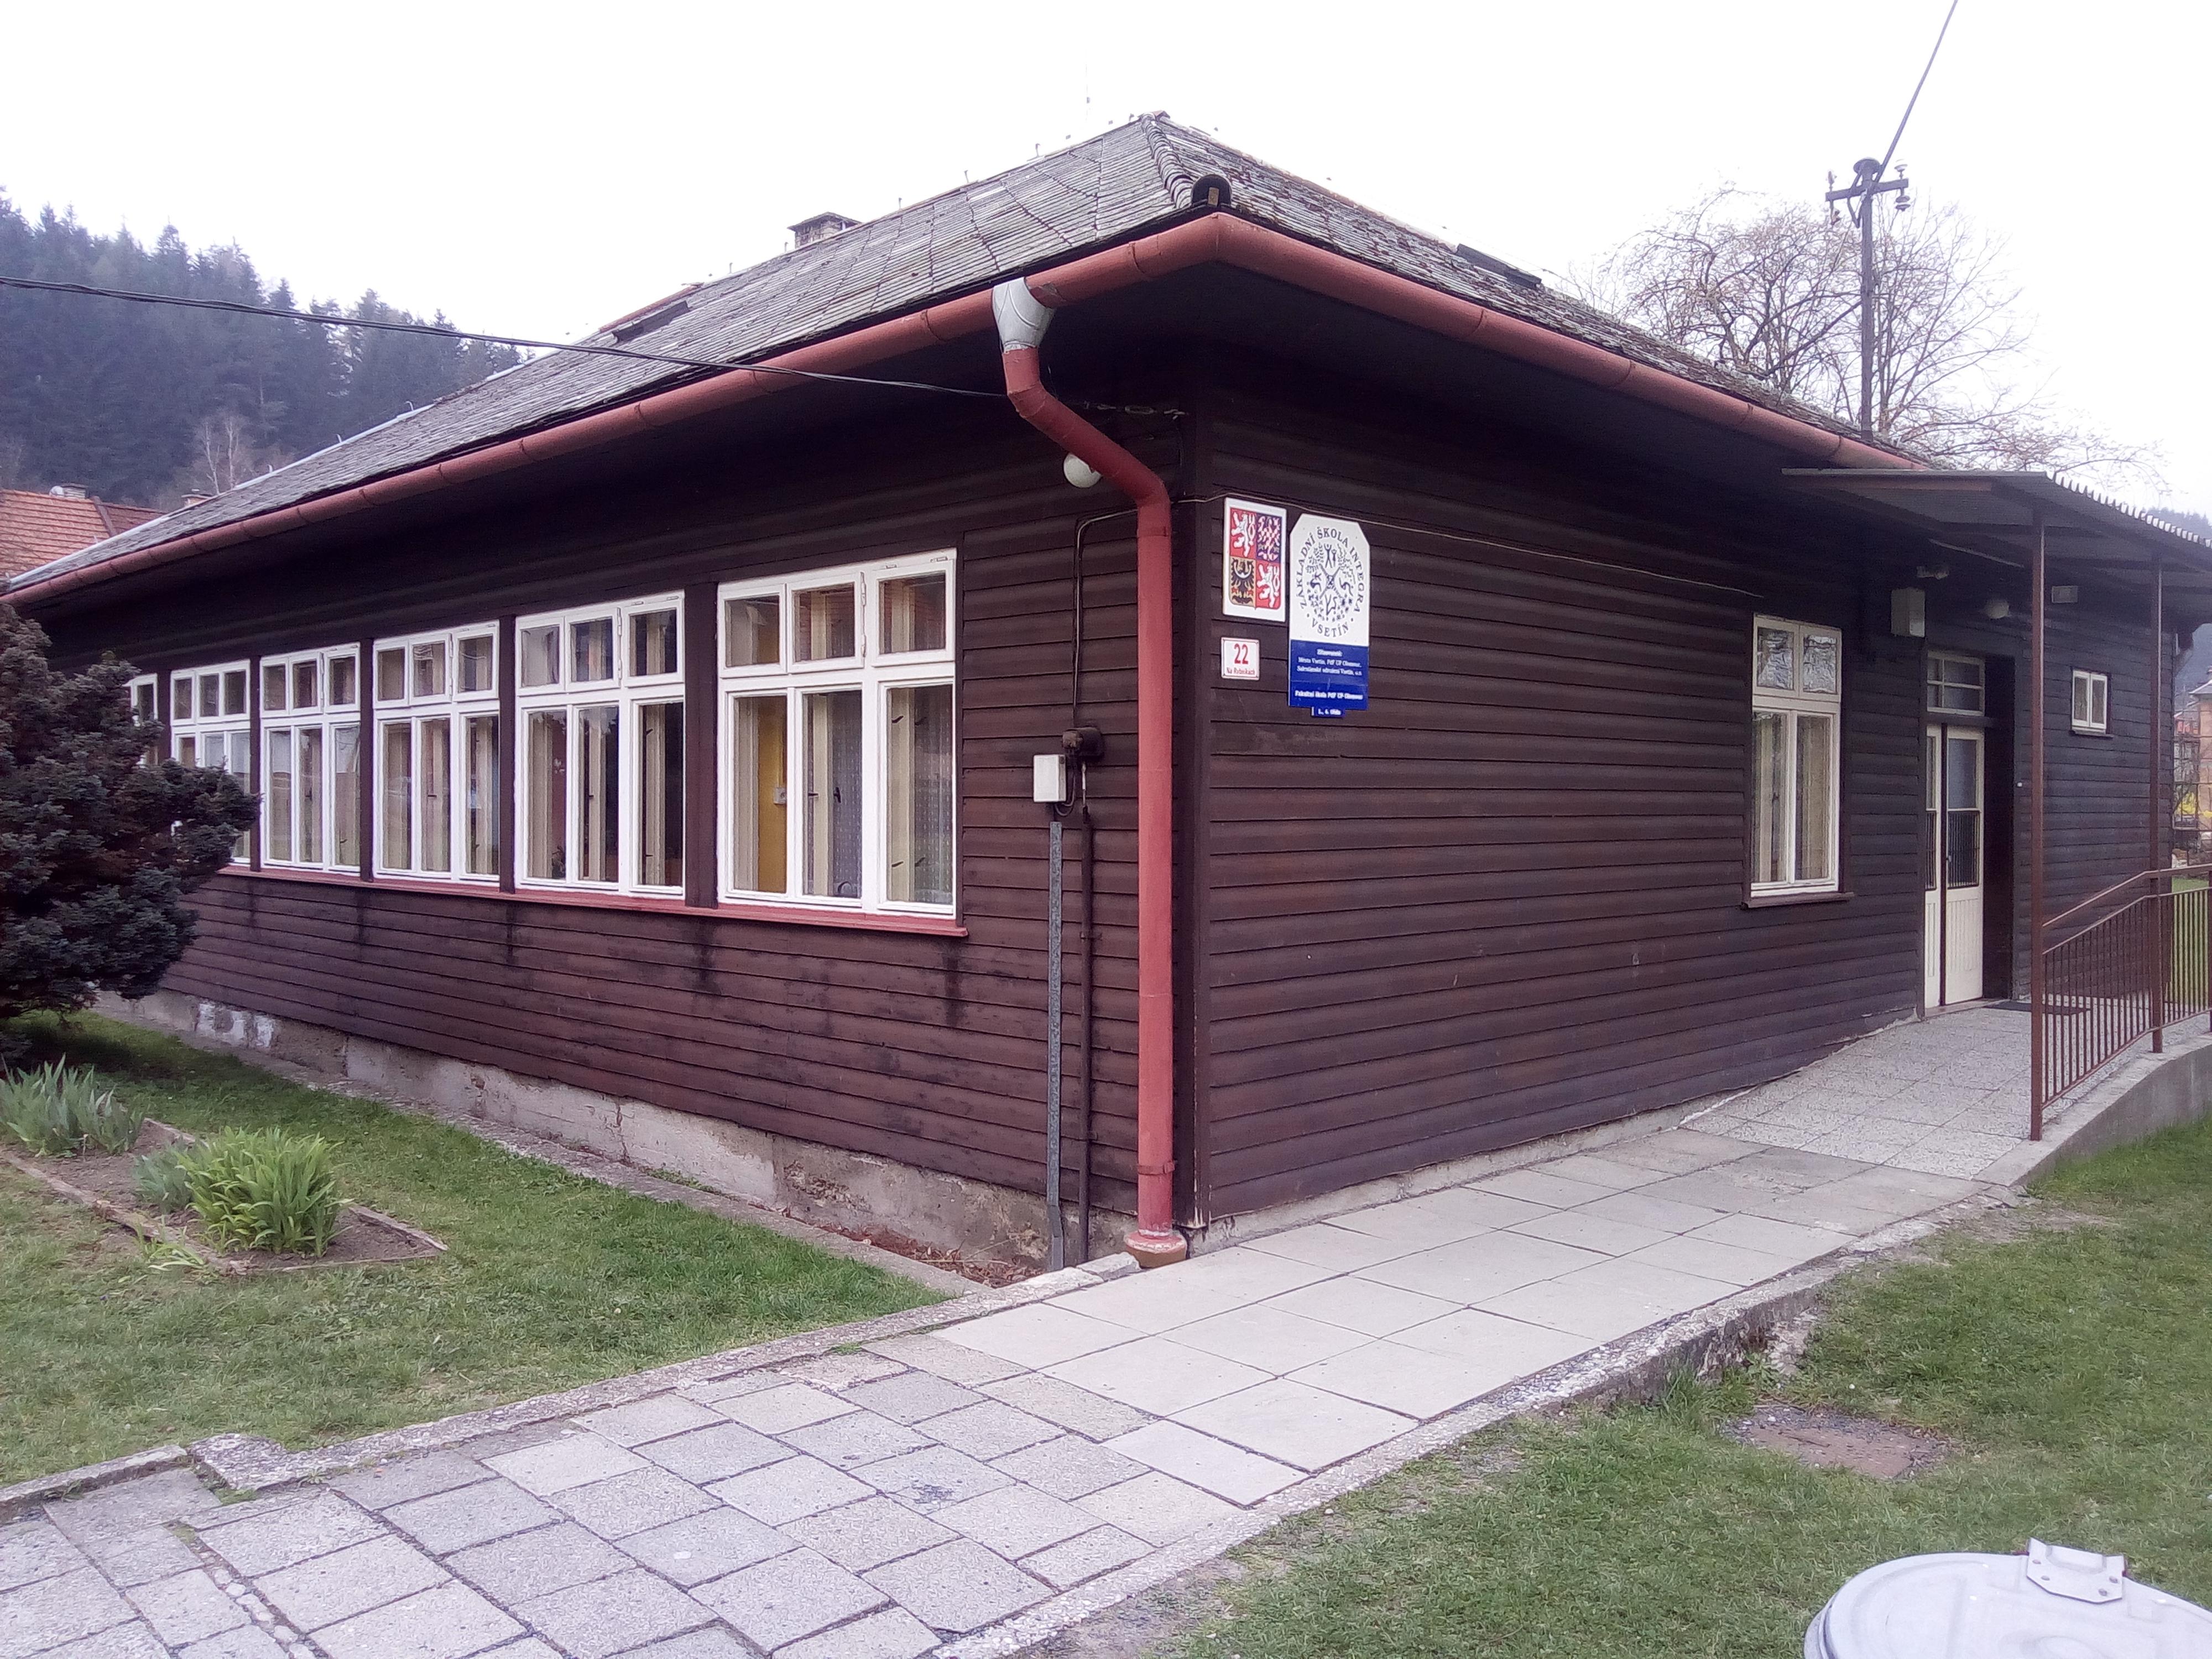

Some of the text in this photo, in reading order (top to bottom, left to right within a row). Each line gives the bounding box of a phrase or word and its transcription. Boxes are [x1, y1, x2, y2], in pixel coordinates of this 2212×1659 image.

[1296, 526, 1365, 613] ZÁKLADNÍ ŠKOLA INTEGRA
[1311, 617, 1349, 638] VSETÍN
[1234, 643, 1249, 665] 22
